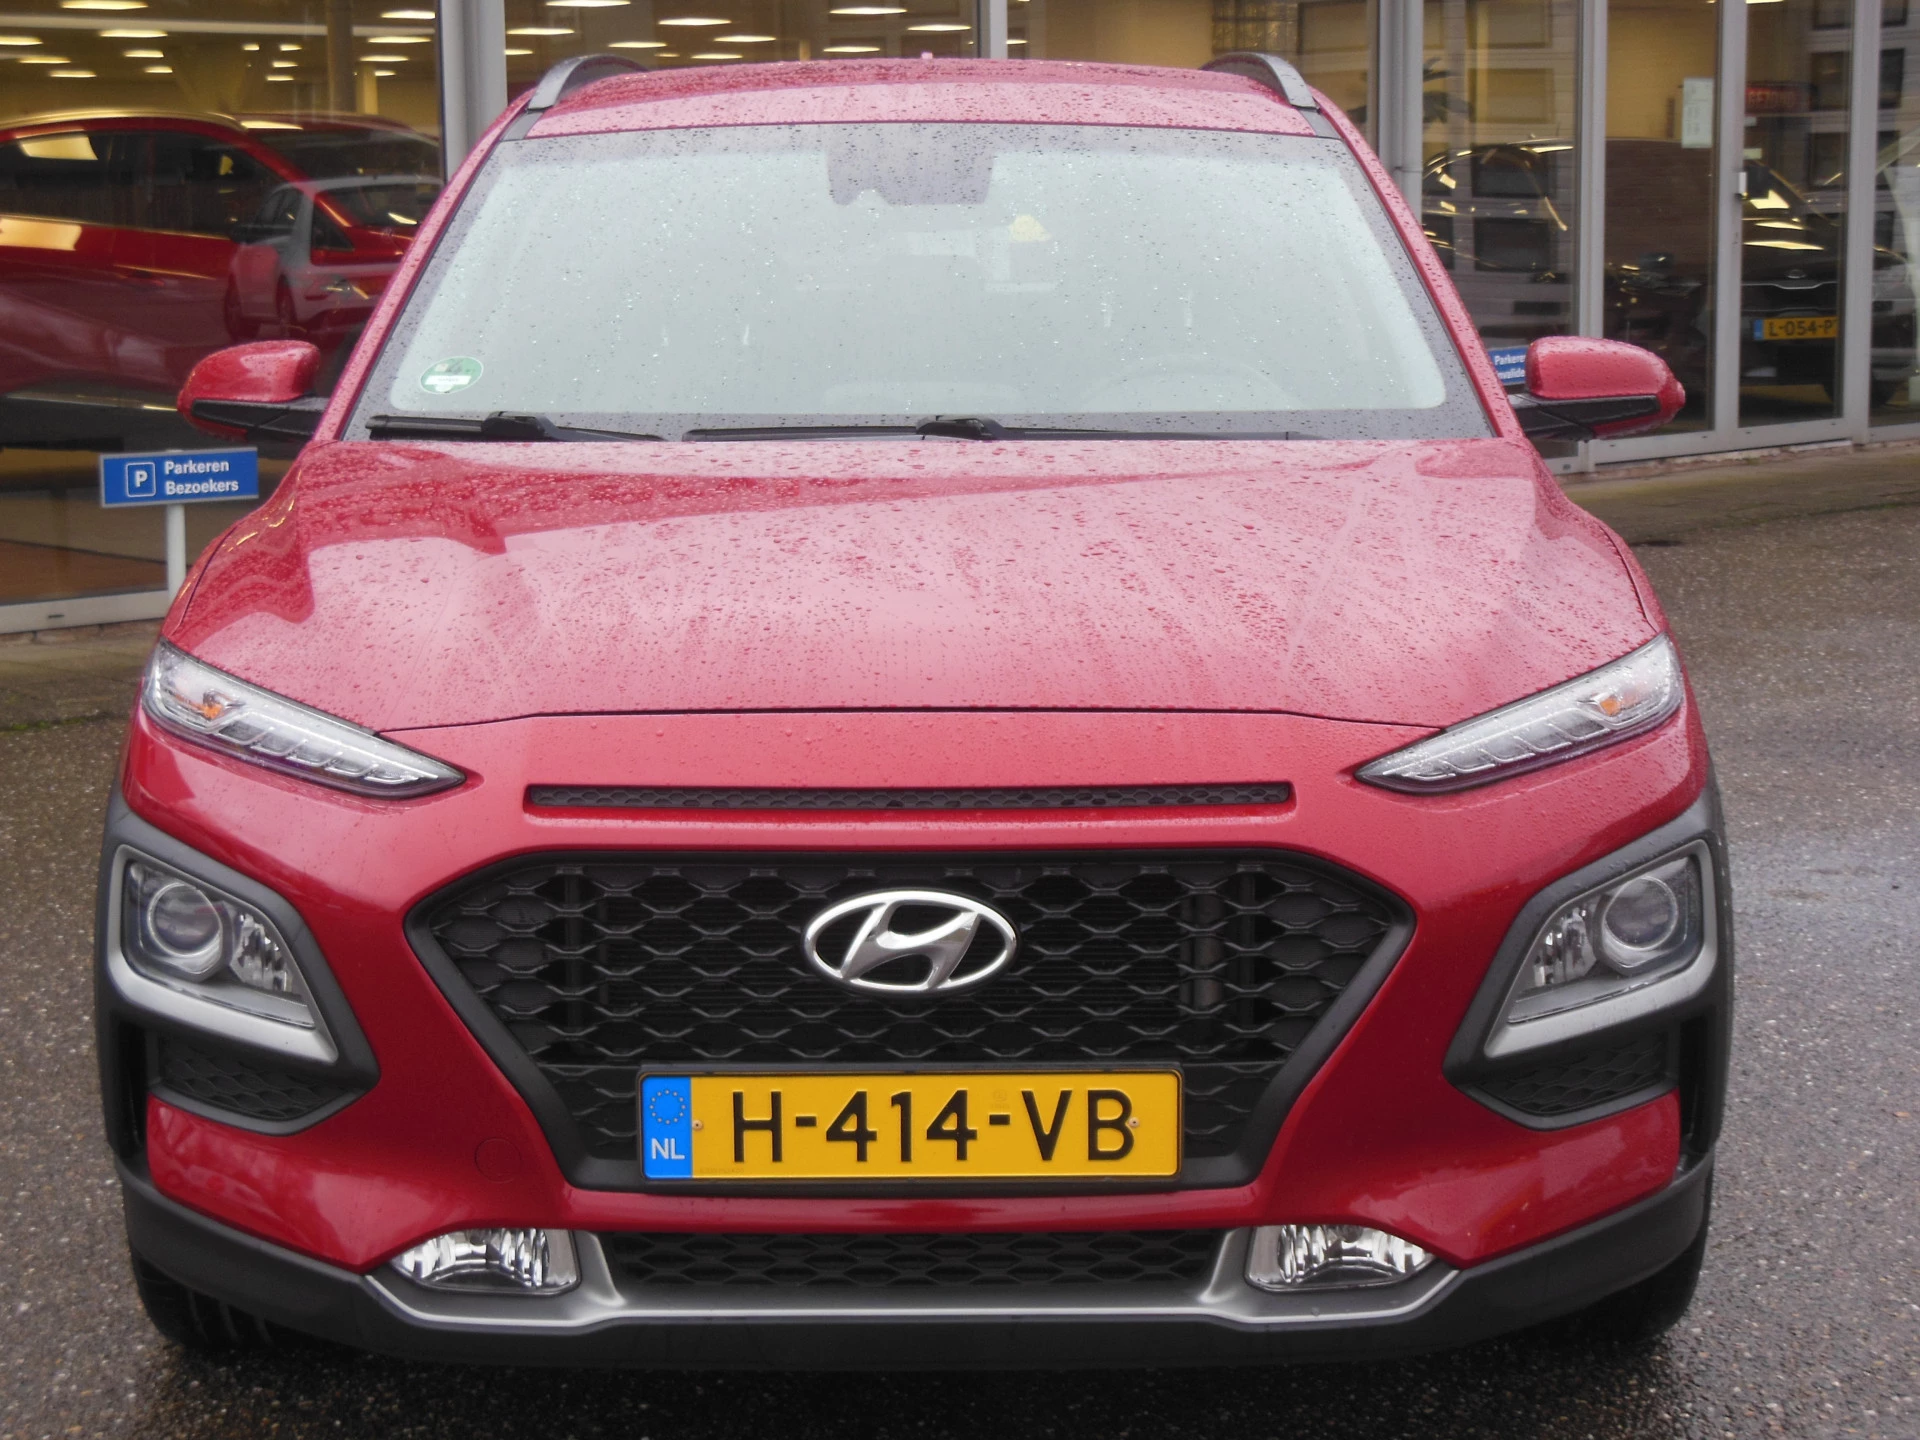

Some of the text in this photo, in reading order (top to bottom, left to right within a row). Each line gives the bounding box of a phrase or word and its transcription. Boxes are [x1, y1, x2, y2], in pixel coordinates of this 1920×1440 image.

[1494, 354, 1526, 365] Parkere
[164, 459, 230, 475] Parkeren
[134, 470, 148, 487] P
[165, 479, 239, 495] Bezoekers
[732, 1089, 1137, 1163] H-414-VB
[650, 1138, 686, 1161] NL
